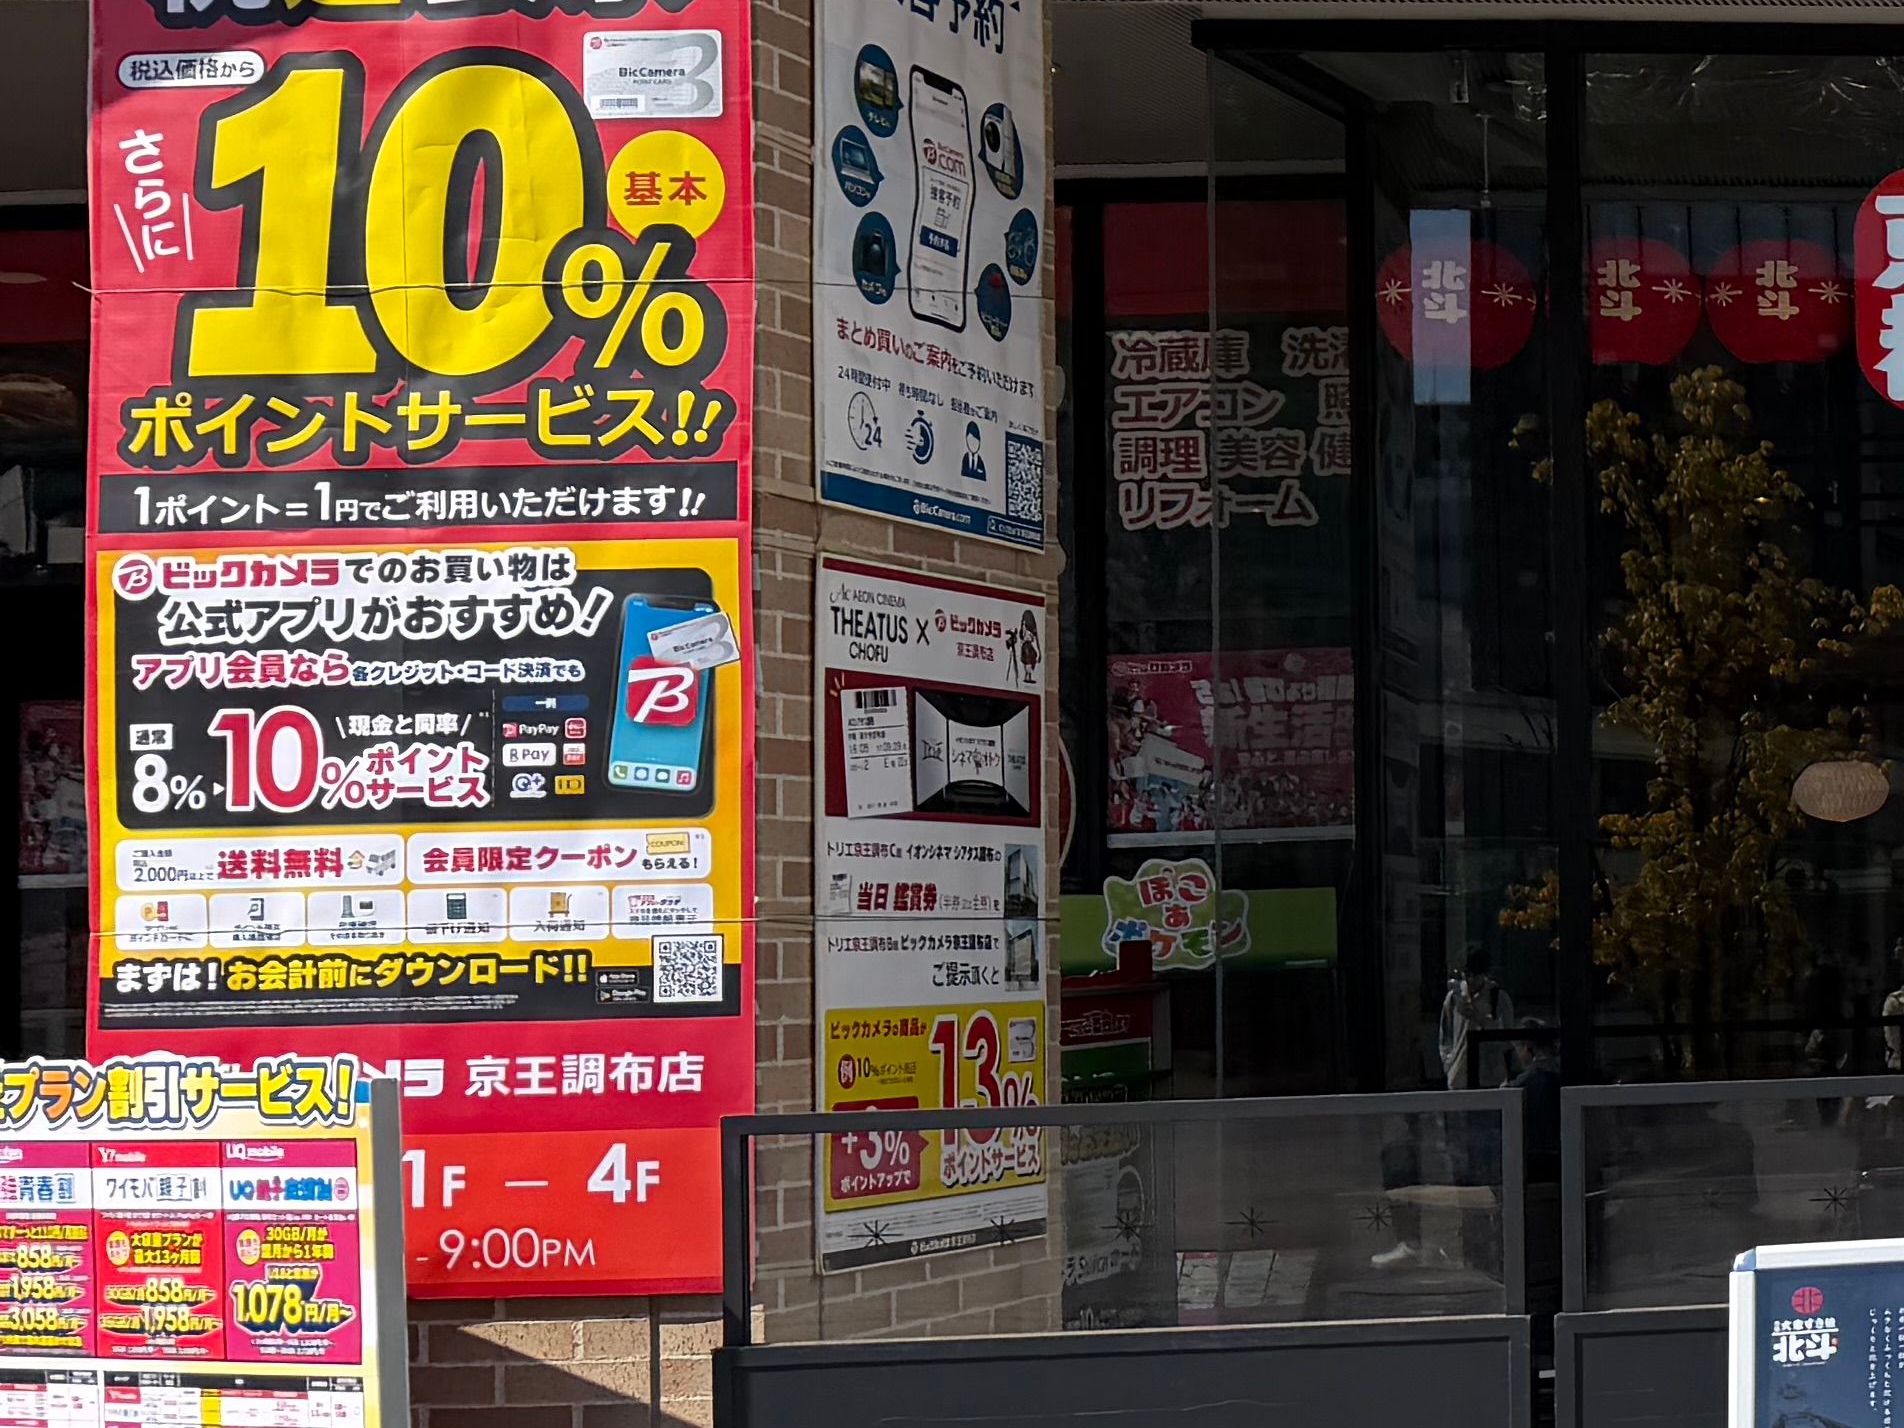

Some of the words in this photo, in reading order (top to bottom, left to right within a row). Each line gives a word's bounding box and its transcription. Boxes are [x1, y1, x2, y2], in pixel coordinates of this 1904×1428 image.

[129, 59, 256, 81] 税込価格から
[120, 128, 181, 259] さらに
[623, 172, 707, 205] 基本
[1114, 333, 1247, 375] 冷蔵庫
[1115, 387, 1281, 423] エアコン
[129, 386, 721, 457] ポイントサービス!!
[1114, 434, 1202, 475] 調理
[1217, 433, 1303, 473] 美容
[1122, 483, 1314, 524] リフォーム
[161, 552, 574, 589] ビックカメラでのお買い物は
[161, 592, 612, 641] 公式アプリがおすすめ!
[830, 606, 908, 644] THEATUS
[950, 614, 1002, 638] ビックカメラ
[849, 641, 889, 663] CHOFU
[133, 654, 349, 686] アプリ会員なら
[352, 660, 585, 683] 各クレジット・コード決済でも
[349, 714, 458, 735] 現金と同率
[519, 723, 560, 735] PayPay
[366, 748, 484, 775] ポイント
[132, 753, 207, 813] 8%
[366, 778, 488, 805] サービス
[218, 847, 344, 879] 送料無料
[423, 846, 637, 872] 会員限定クーポン
[857, 882, 889, 911] 当日
[893, 882, 938, 911] 鑑賞券
[115, 961, 218, 992] まずは!
[933, 961, 999, 987] ご提示頂くと
[466, 1053, 703, 1097] 京王調布店
[0, 1063, 352, 1120] プラン割引サービス!
[587, 1143, 660, 1203] 4F
[1772, 1332, 1838, 1363] 北斗
